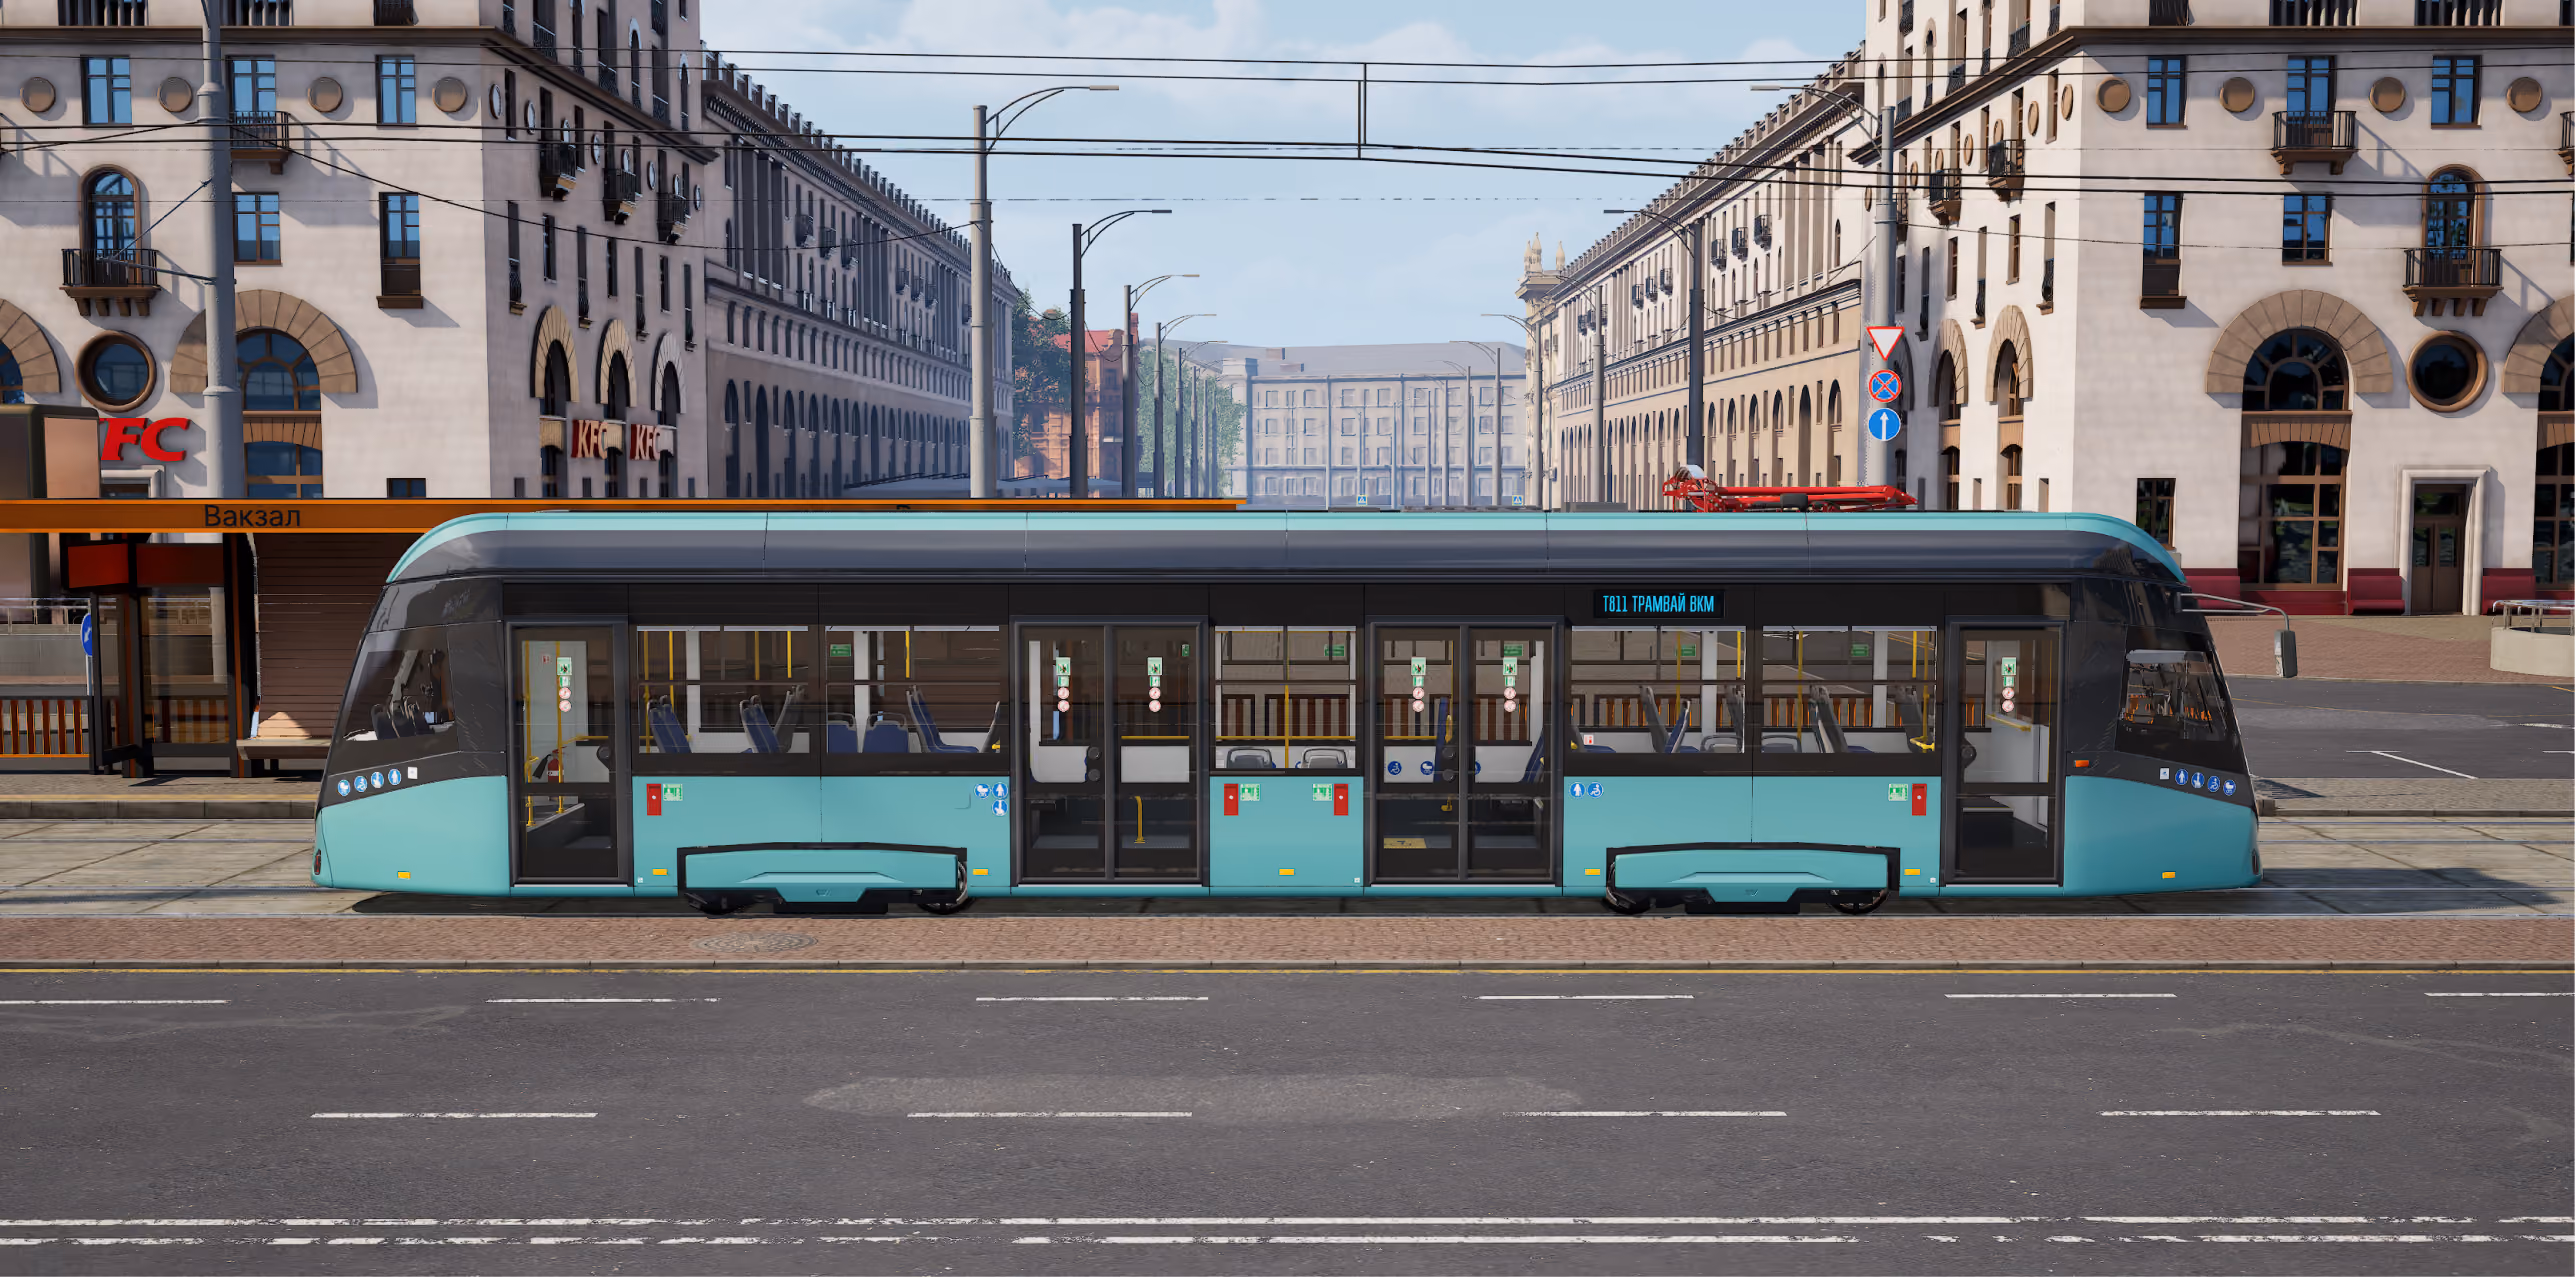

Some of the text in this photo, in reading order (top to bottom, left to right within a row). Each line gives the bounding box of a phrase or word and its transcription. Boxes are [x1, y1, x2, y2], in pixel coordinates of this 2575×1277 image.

[99, 417, 191, 462] FC
[572, 419, 608, 460] KFC
[630, 424, 661, 461] KFC
[204, 505, 301, 527] Вакзал
[1603, 592, 1714, 612] Т811 ТРАМВАЙ ВКМ
